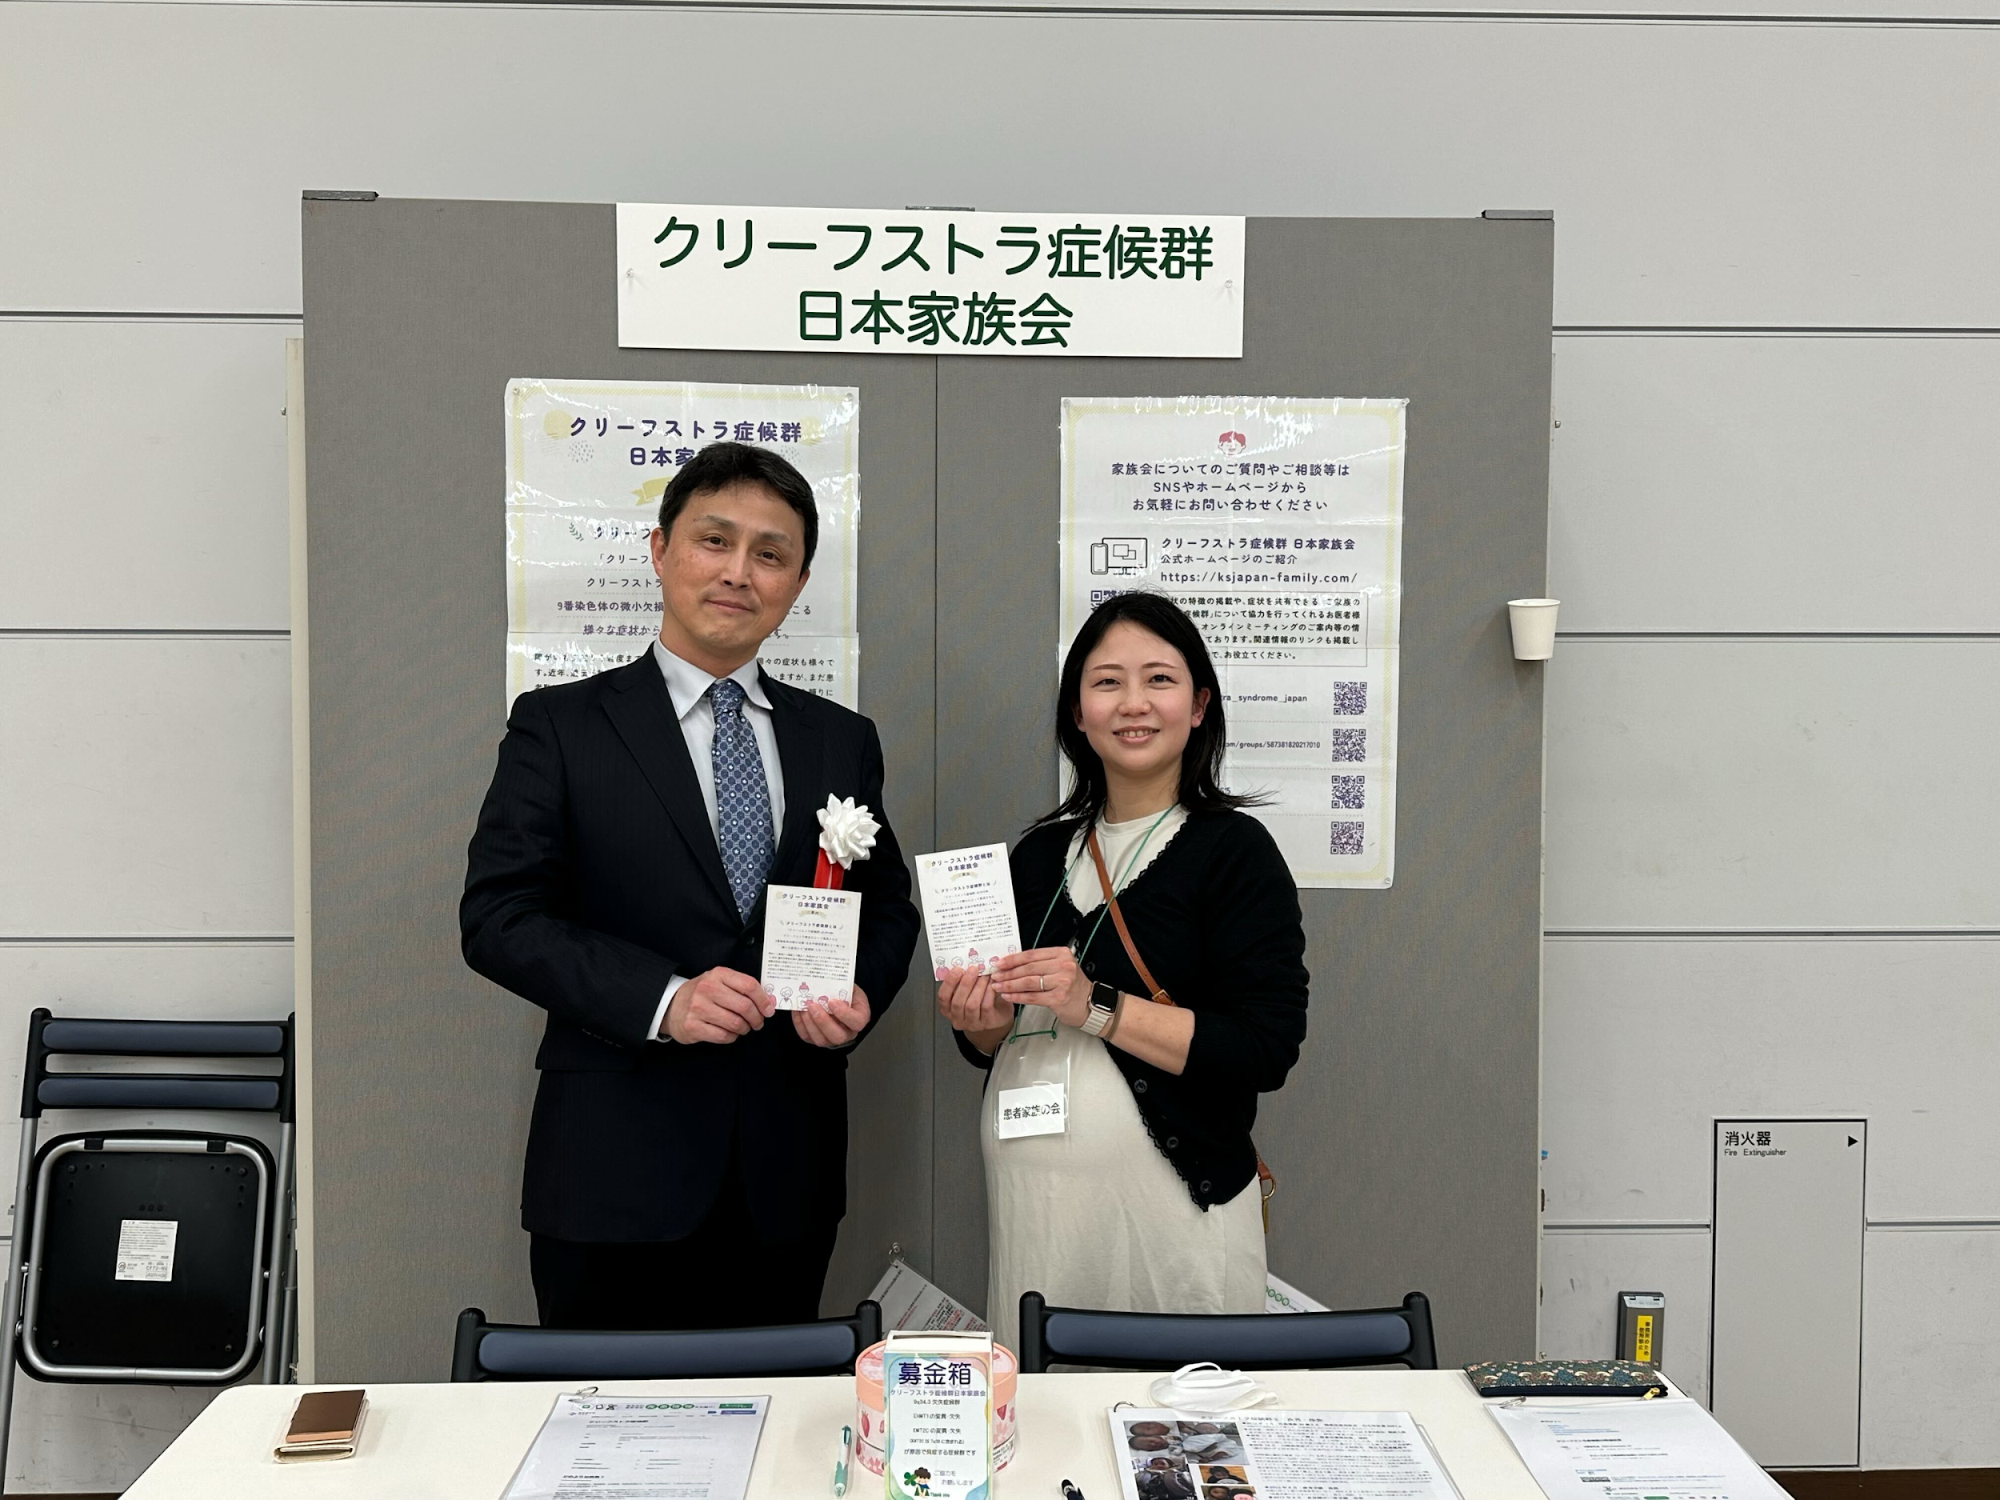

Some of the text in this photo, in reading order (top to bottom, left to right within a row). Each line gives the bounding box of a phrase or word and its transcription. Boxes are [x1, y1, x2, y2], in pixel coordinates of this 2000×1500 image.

[654, 216, 1214, 281] クリーフストラ症候群
[800, 289, 1073, 348] 日本家族会
[570, 417, 801, 443] クリーフストラ症候群
[1111, 463, 1350, 477] 家族会についてのご質問やご相談等は
[1153, 481, 1307, 494] SNSやホームページから
[1133, 498, 1328, 511] お気軽にお問い合わせください
[1162, 537, 1356, 551] クリーフストラ症候群 日本家族会
[1160, 553, 1298, 565] 公式ホームページのご紹介
[1160, 571, 1359, 585] https://ksjapan-family.com/
[1003, 1102, 1061, 1121] 患者家族の会
[1724, 1131, 1772, 1147] 消火器
[1743, 1149, 1787, 1157] Extinguisher
[898, 1362, 972, 1385] 募金箱
